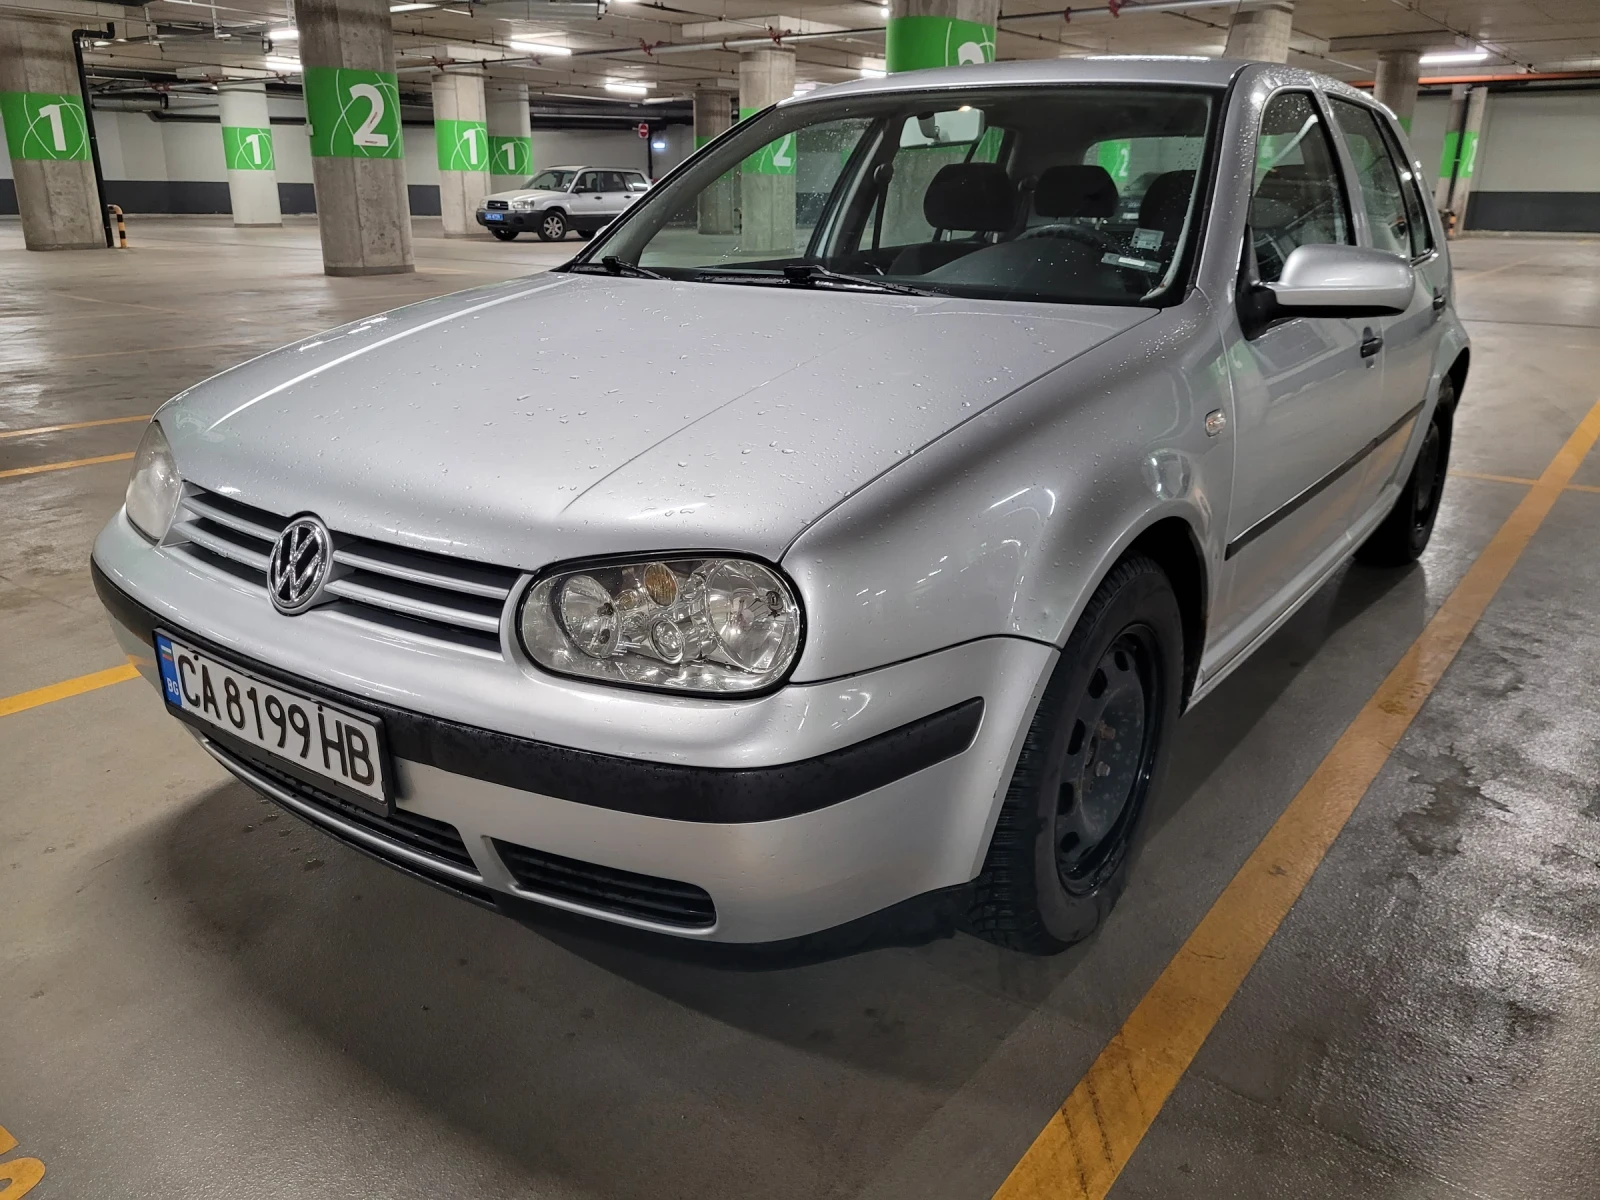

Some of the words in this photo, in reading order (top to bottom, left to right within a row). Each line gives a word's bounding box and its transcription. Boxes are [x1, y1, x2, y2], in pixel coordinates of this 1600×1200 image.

[39, 104, 67, 151] 1
[349, 83, 388, 147] 2
[246, 134, 261, 164] 1
[463, 128, 478, 165] 1
[501, 142, 515, 170] 1
[271, 521, 325, 606] VW
[167, 677, 180, 696] BG
